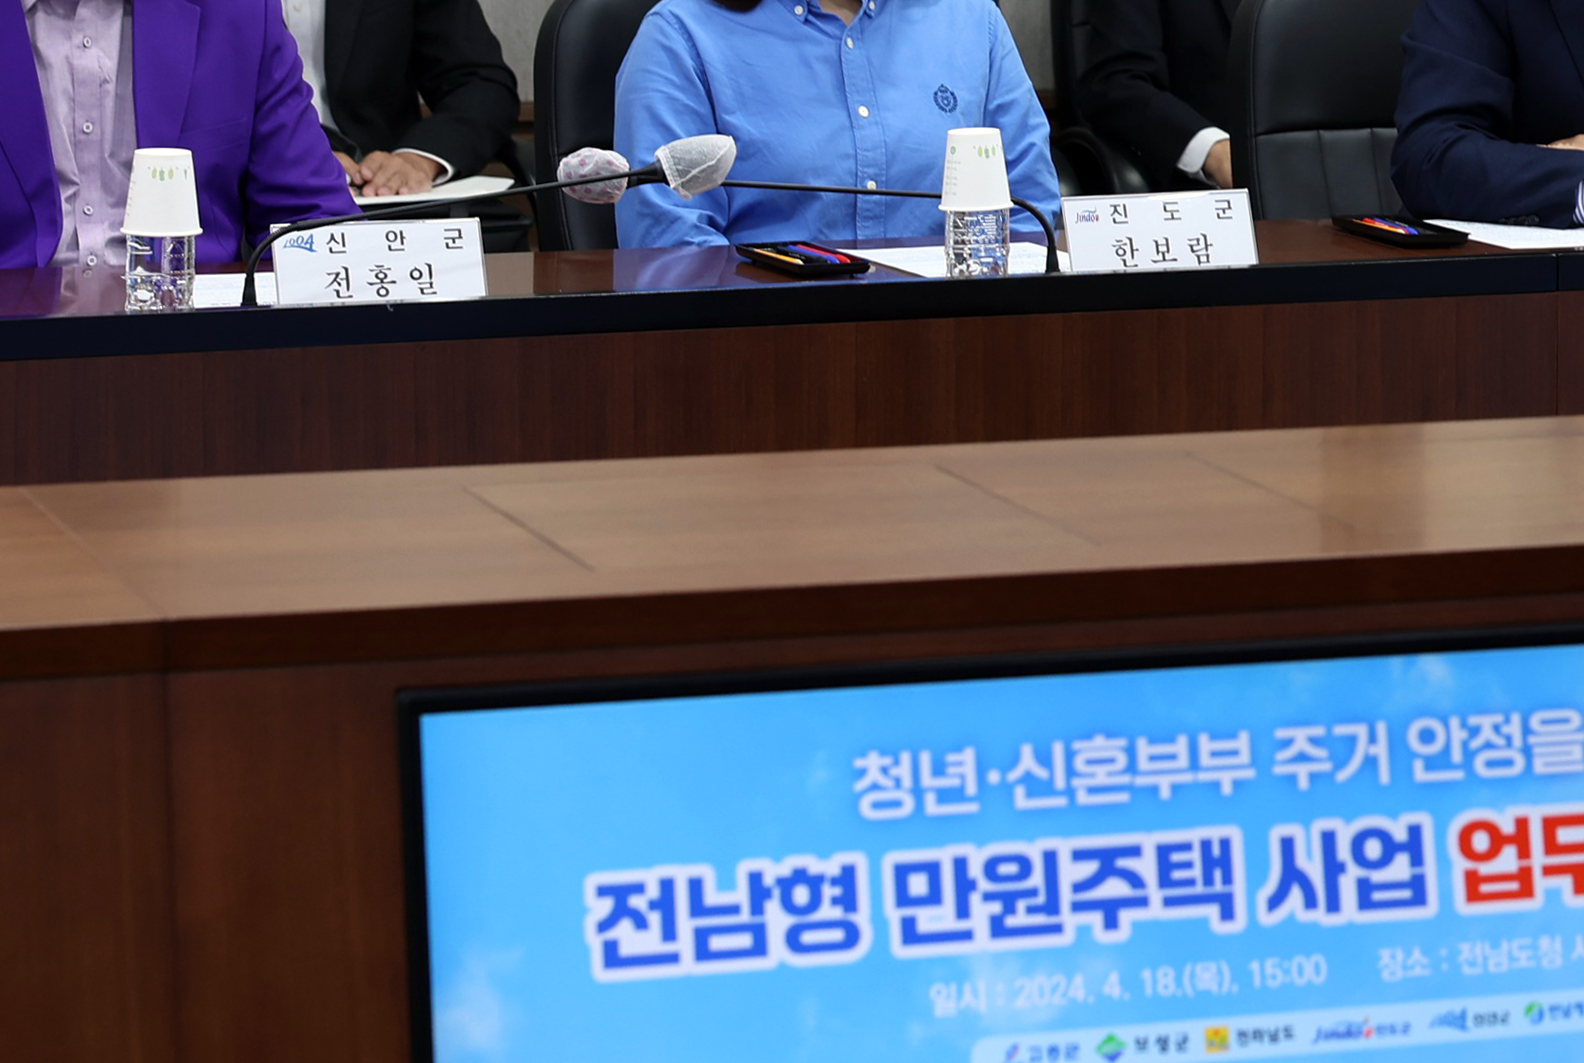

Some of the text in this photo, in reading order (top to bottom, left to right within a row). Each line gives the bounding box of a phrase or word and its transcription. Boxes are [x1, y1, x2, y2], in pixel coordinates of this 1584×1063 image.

[1111, 232, 1213, 268] 한보람
[324, 262, 437, 299] 전홍일
[1270, 719, 1392, 792] 주거
[588, 859, 866, 974] 전남형
[888, 835, 1240, 950] 만원주택
[1263, 821, 1430, 917] 사업
[929, 980, 986, 1019] 일시
[1249, 952, 1329, 990] 15:00
[1377, 945, 1432, 983] 장소
[1457, 934, 1564, 976] 전남도청
